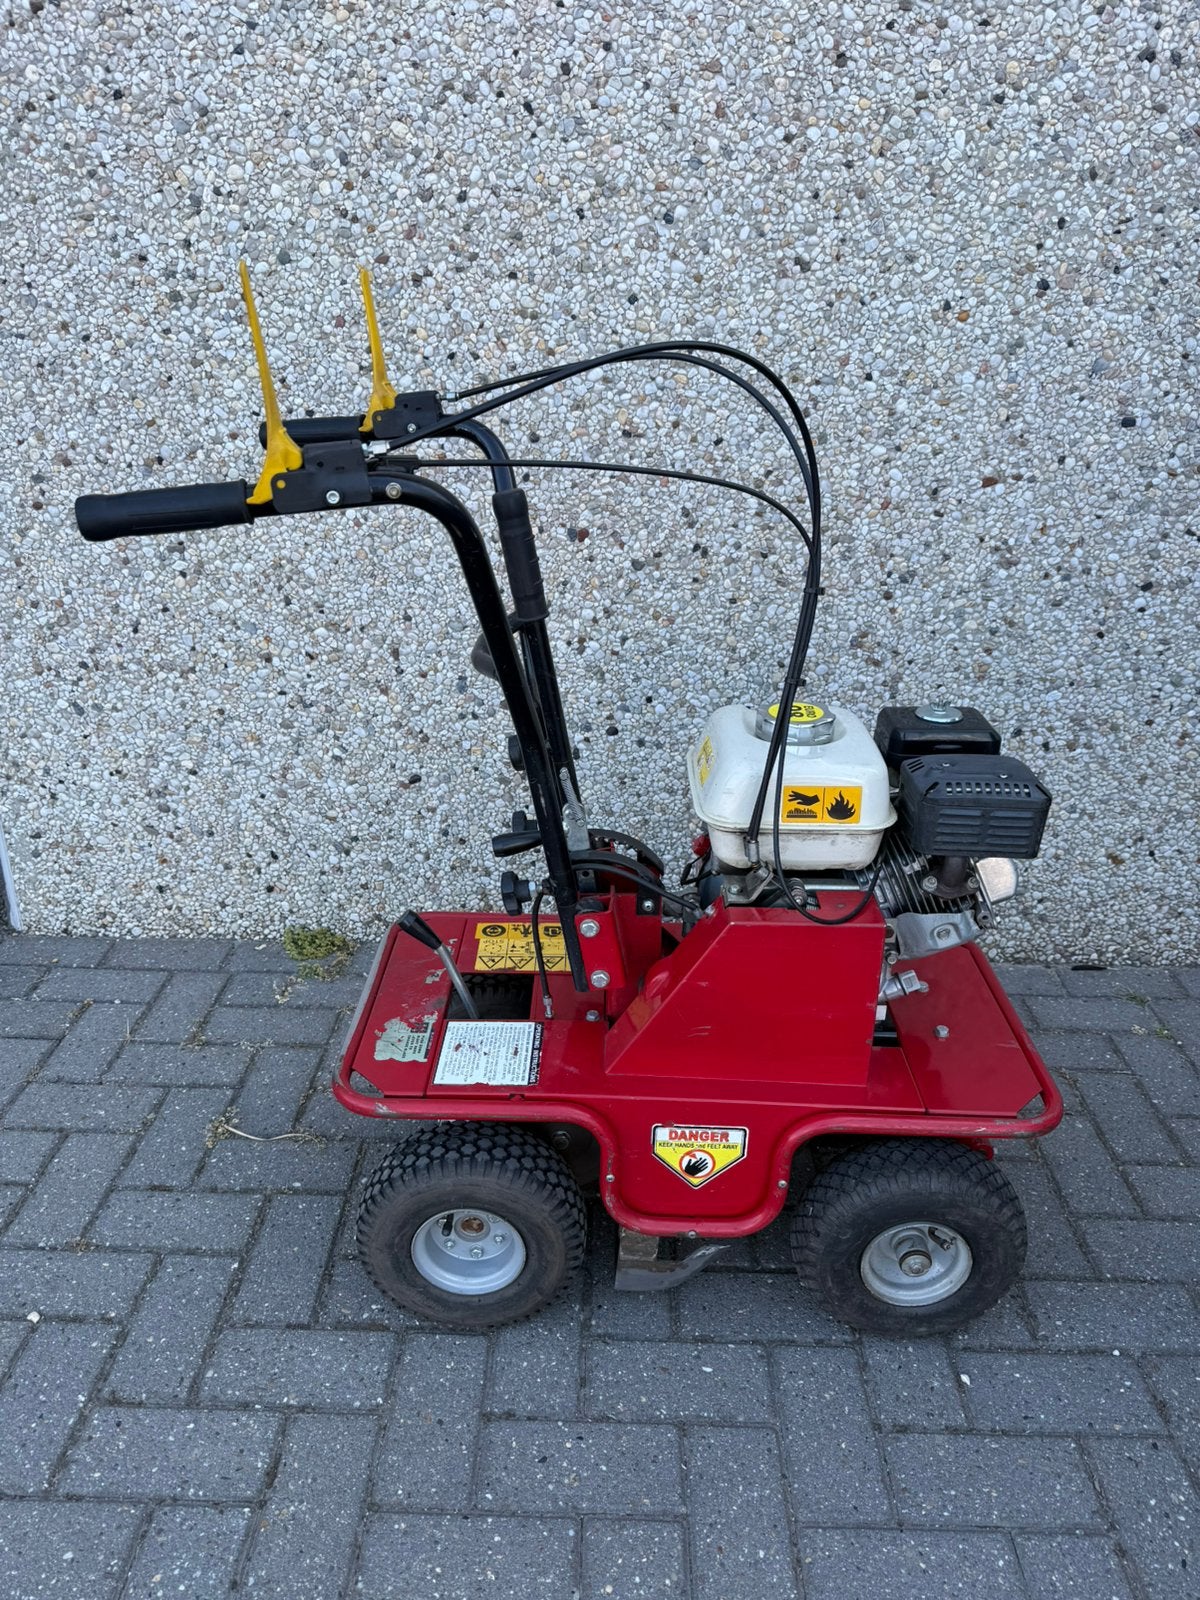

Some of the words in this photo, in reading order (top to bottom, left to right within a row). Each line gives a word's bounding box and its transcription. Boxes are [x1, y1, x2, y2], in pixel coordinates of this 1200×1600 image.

[533, 1023, 542, 1049] OPERATING
[530, 1049, 540, 1083] INSTRUCTIONS
[668, 1129, 730, 1143] DANGER
